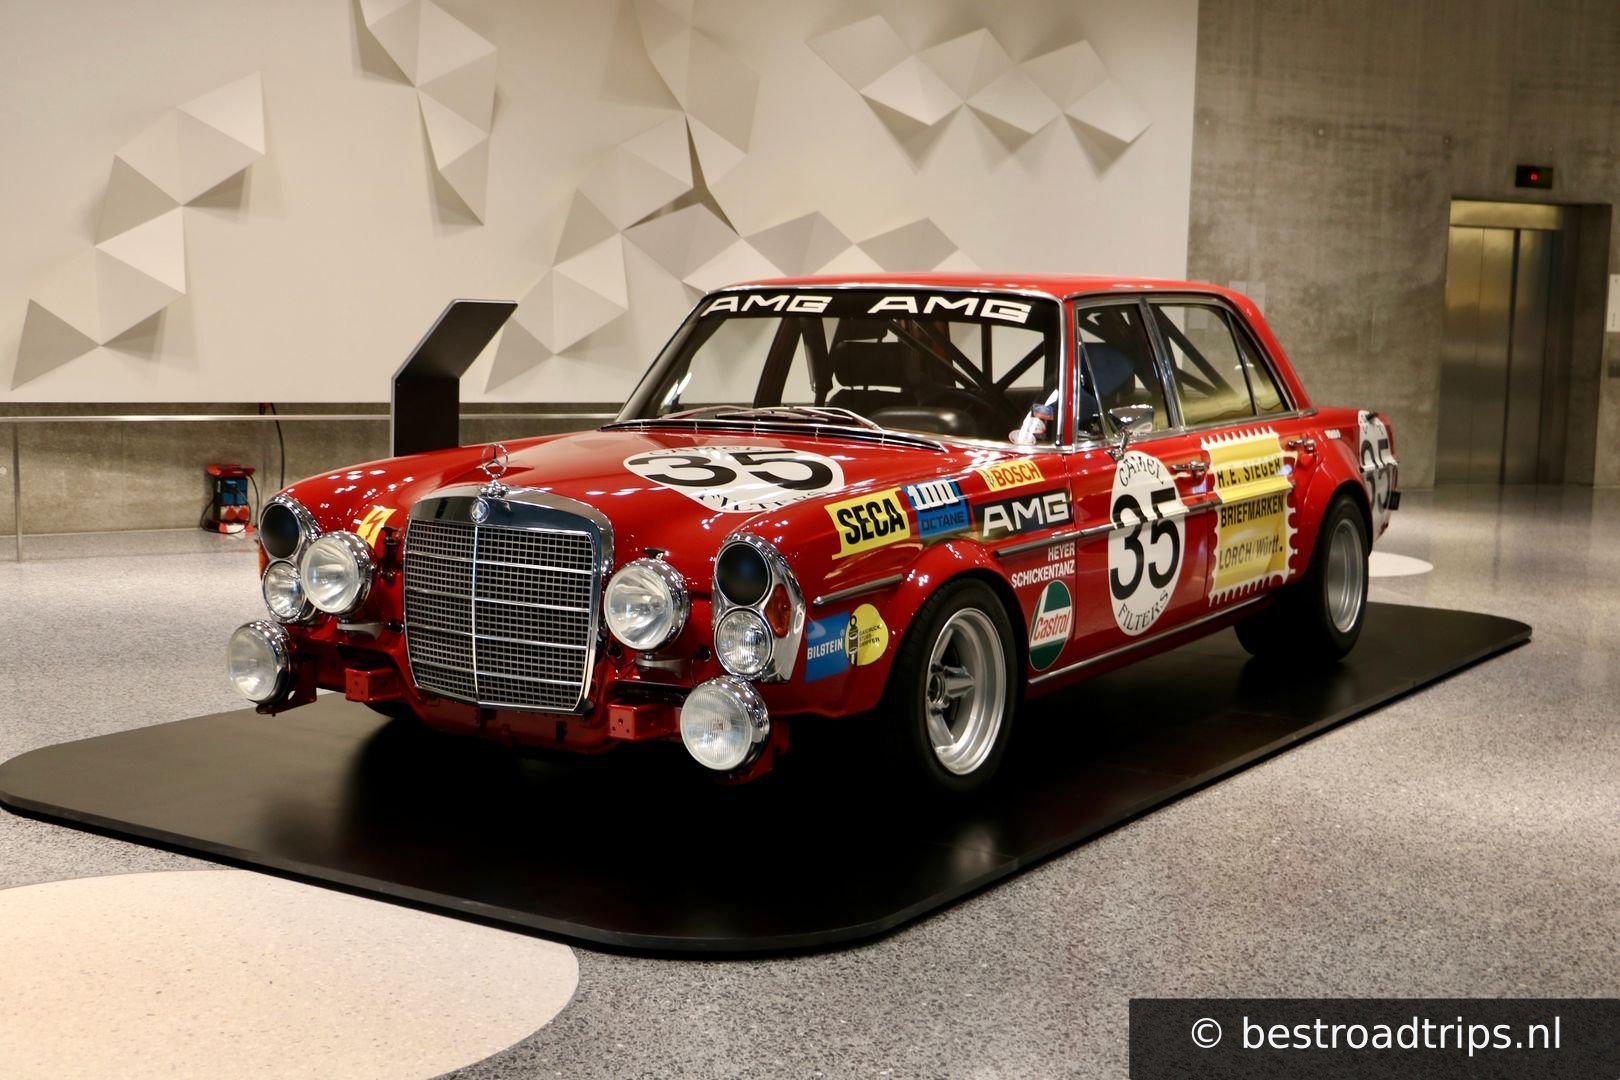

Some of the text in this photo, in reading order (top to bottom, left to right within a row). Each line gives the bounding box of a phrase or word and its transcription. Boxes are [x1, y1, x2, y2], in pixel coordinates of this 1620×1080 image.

[700, 295, 1032, 324] AMG AMG
[628, 450, 833, 491] 35
[992, 462, 1042, 487] BOSCH
[1119, 456, 1164, 487] CAMEL
[1243, 456, 1281, 481] SIEGER
[906, 479, 960, 512] 100
[836, 498, 906, 546] SECA
[921, 511, 965, 532] OCTANE
[982, 492, 1070, 537] AMG
[1220, 494, 1285, 529] BRIEFMARKEN
[1048, 542, 1075, 561] HEYER
[1110, 487, 1181, 601] 35
[1011, 560, 1075, 589] SCHICKENTANZ
[1033, 610, 1071, 641] Castrol
[1118, 590, 1169, 632] FILTERS
[807, 637, 843, 660] BILSTEIN
